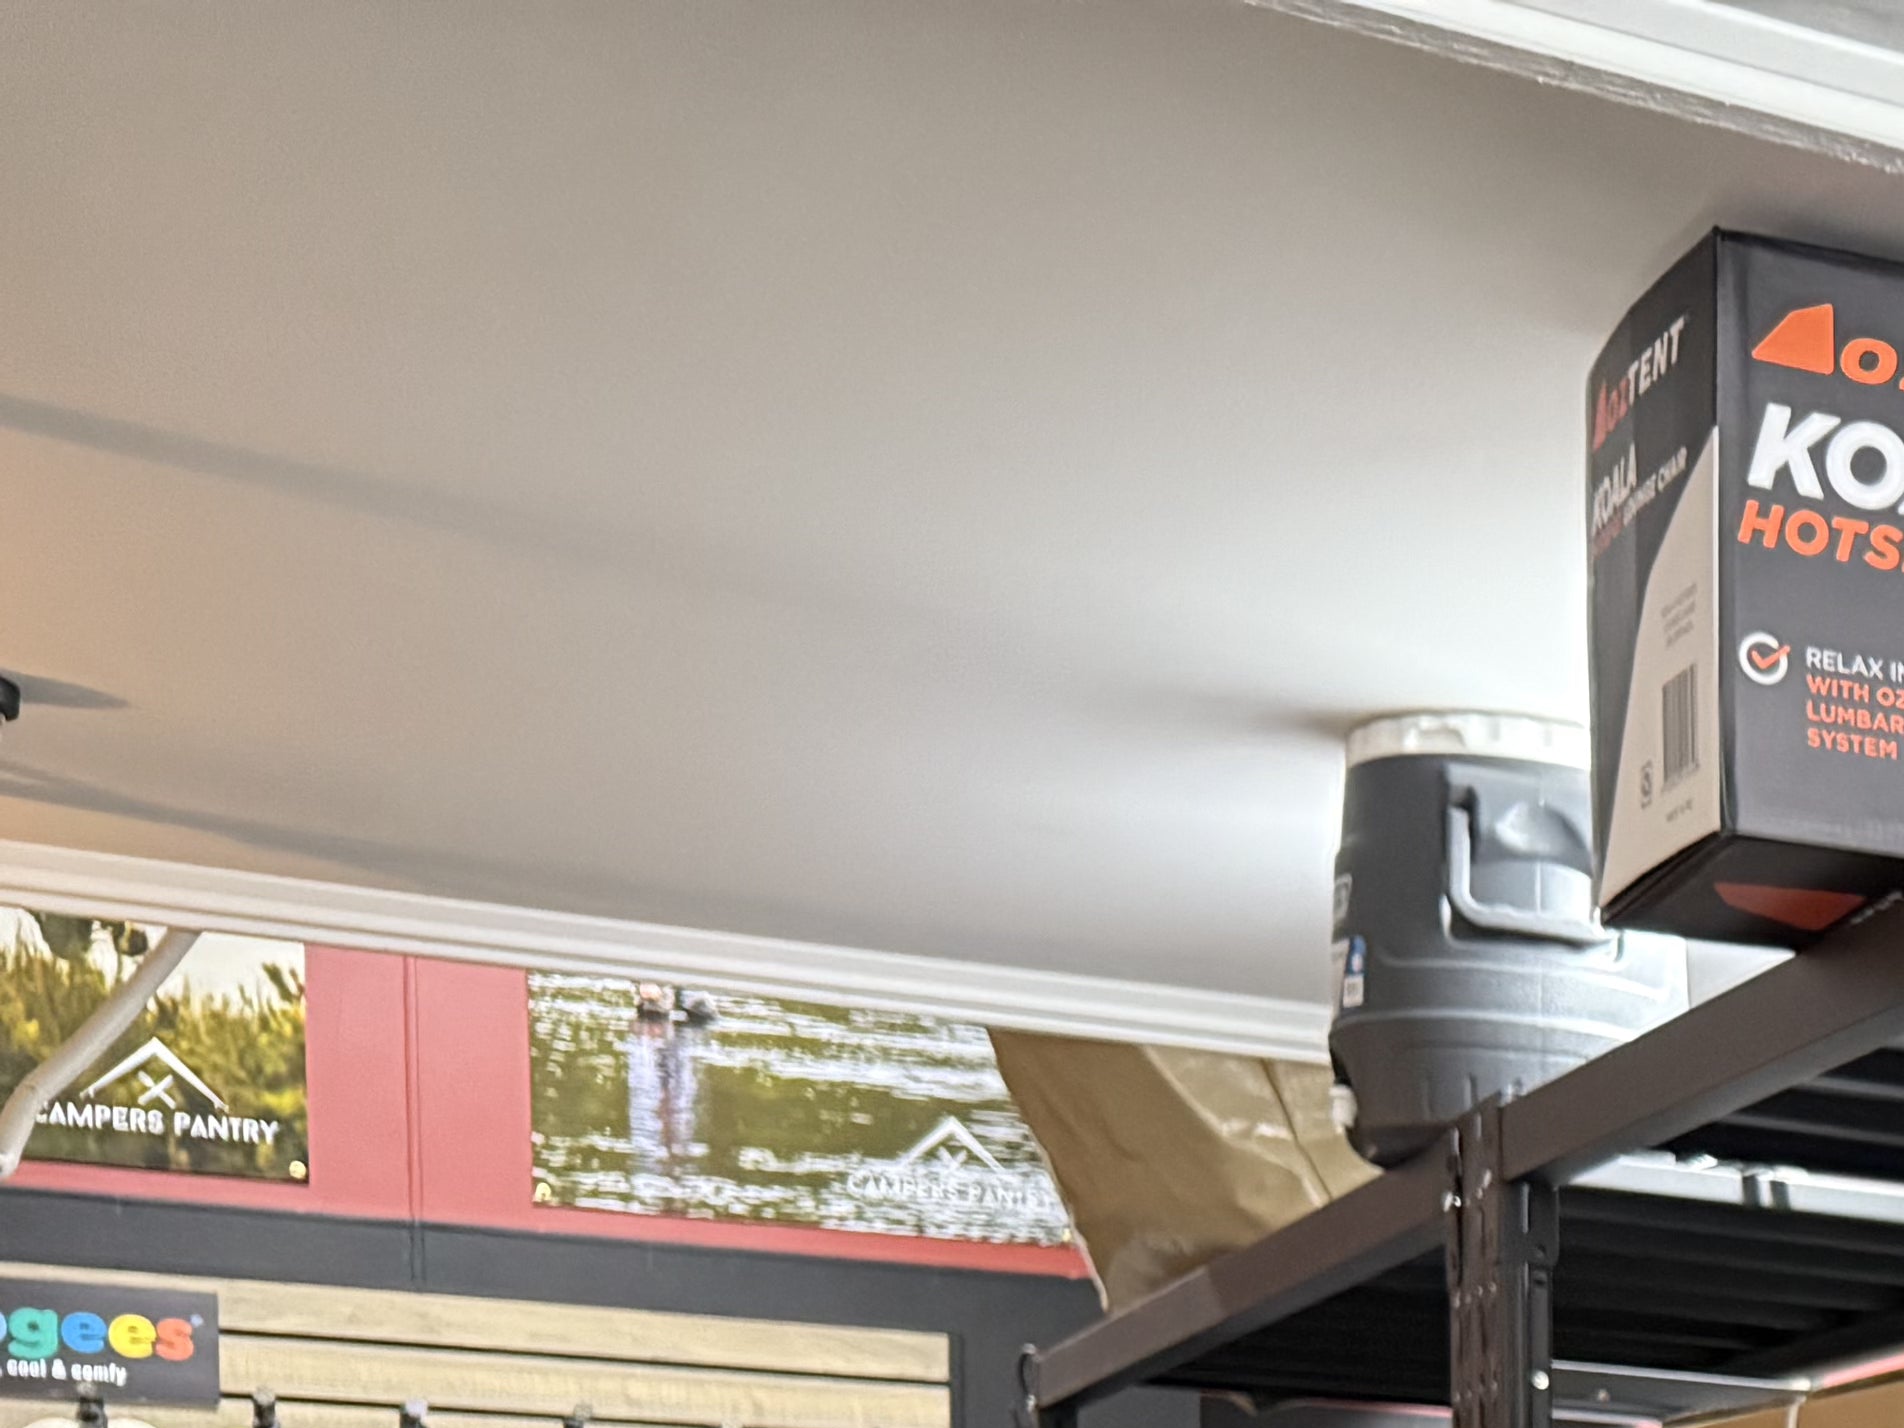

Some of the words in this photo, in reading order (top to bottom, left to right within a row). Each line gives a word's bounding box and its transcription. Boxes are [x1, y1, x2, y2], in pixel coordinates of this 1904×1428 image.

[1806, 647, 1883, 680] RELAX
[1807, 675, 1870, 702] WITH
[1807, 701, 1904, 735] LUMBAR
[1807, 729, 1898, 759] SYSTEM
[35, 1102, 164, 1134] CAMPERS
[173, 1112, 278, 1145] PANTRY
[0, 1307, 194, 1361] gees
